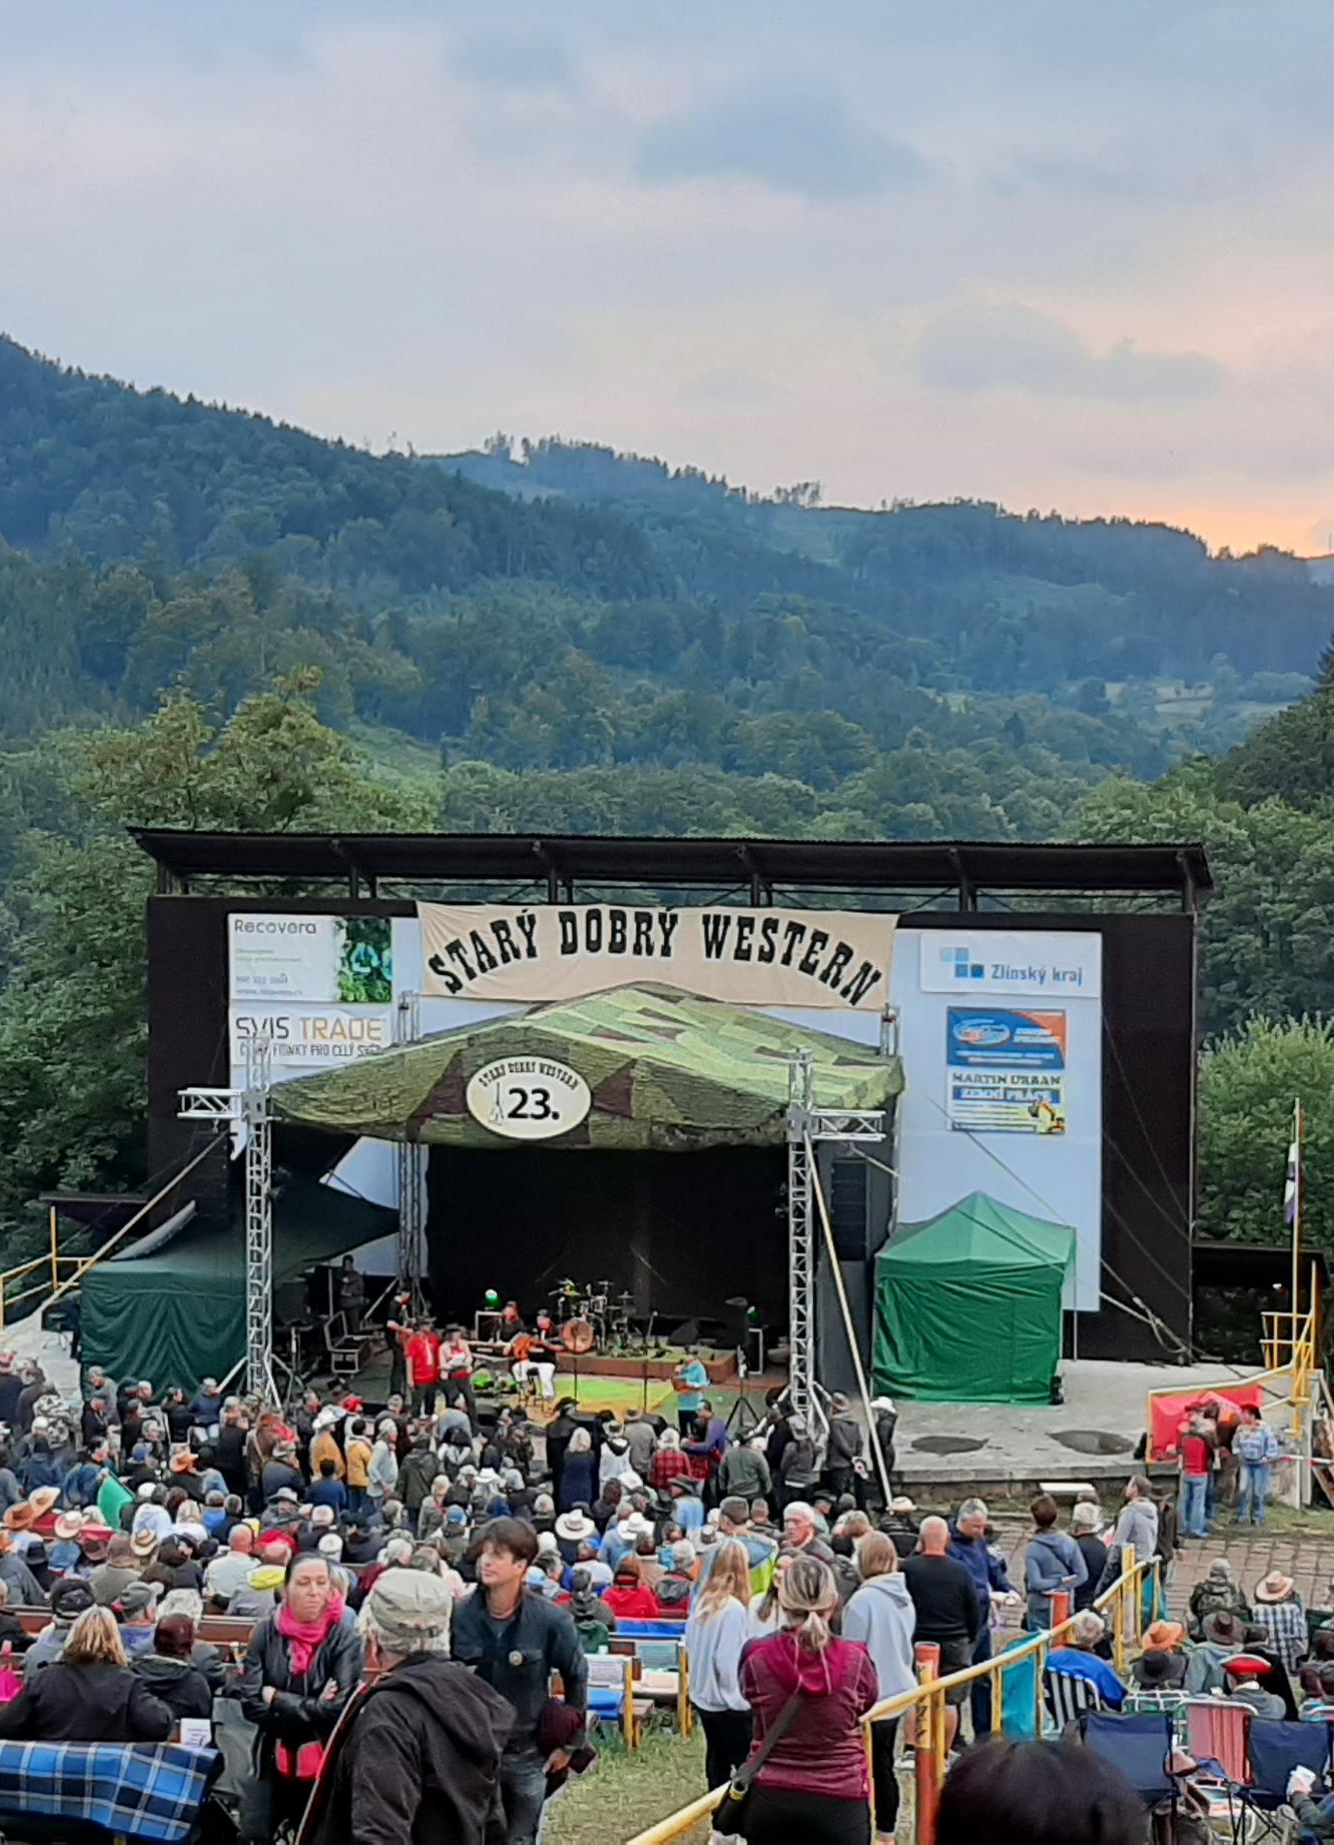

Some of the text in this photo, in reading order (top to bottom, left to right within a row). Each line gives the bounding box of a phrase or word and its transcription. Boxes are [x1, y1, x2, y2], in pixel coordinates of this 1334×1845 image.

[235, 919, 316, 934] Recovera
[428, 909, 537, 995] STARÝ
[703, 913, 882, 1006] WESTERN
[991, 963, 1083, 987] Zlínský kraj
[236, 1017, 382, 1041] SVIS TRADE
[953, 1073, 1007, 1084] MARTIN
[508, 1087, 560, 1120] 23.
